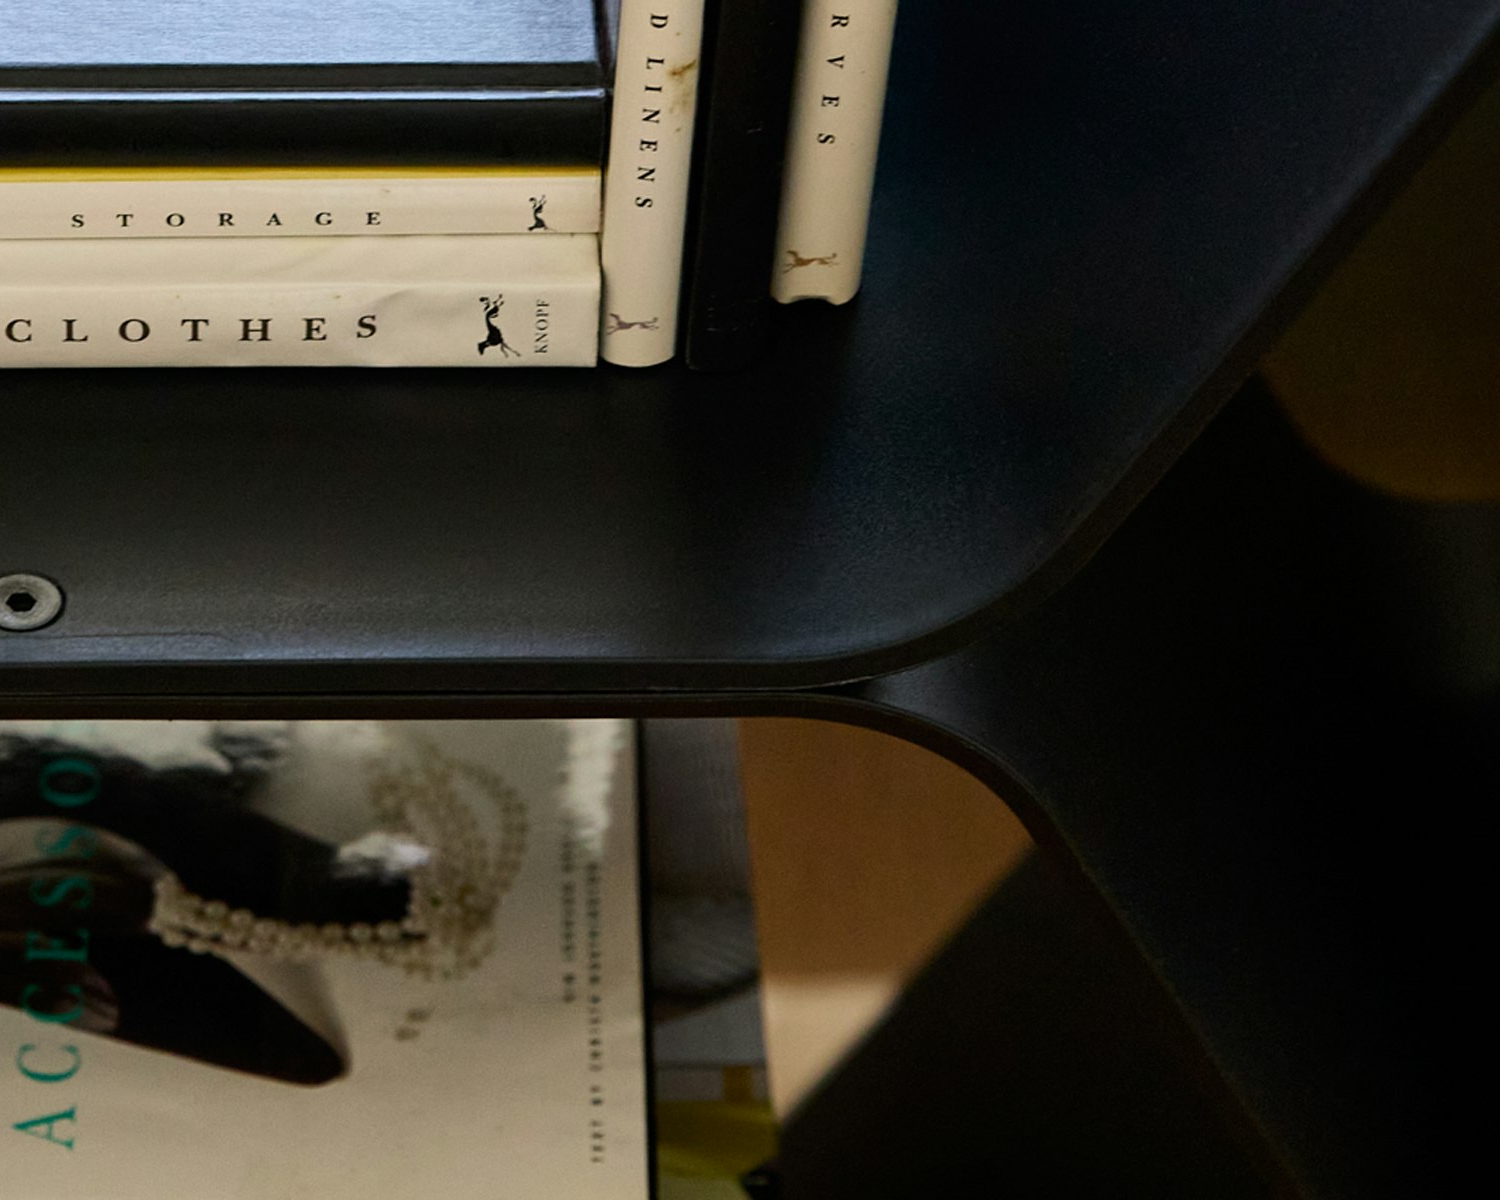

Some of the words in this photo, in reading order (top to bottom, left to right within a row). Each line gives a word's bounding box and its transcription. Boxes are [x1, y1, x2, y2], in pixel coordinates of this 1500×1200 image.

[635, 56, 665, 209] LINENS
[70, 210, 382, 229] STORAGE
[4, 313, 379, 344] CLOTHES
[534, 299, 549, 354] KNOPF
[12, 725, 100, 1150] ACCESSO
